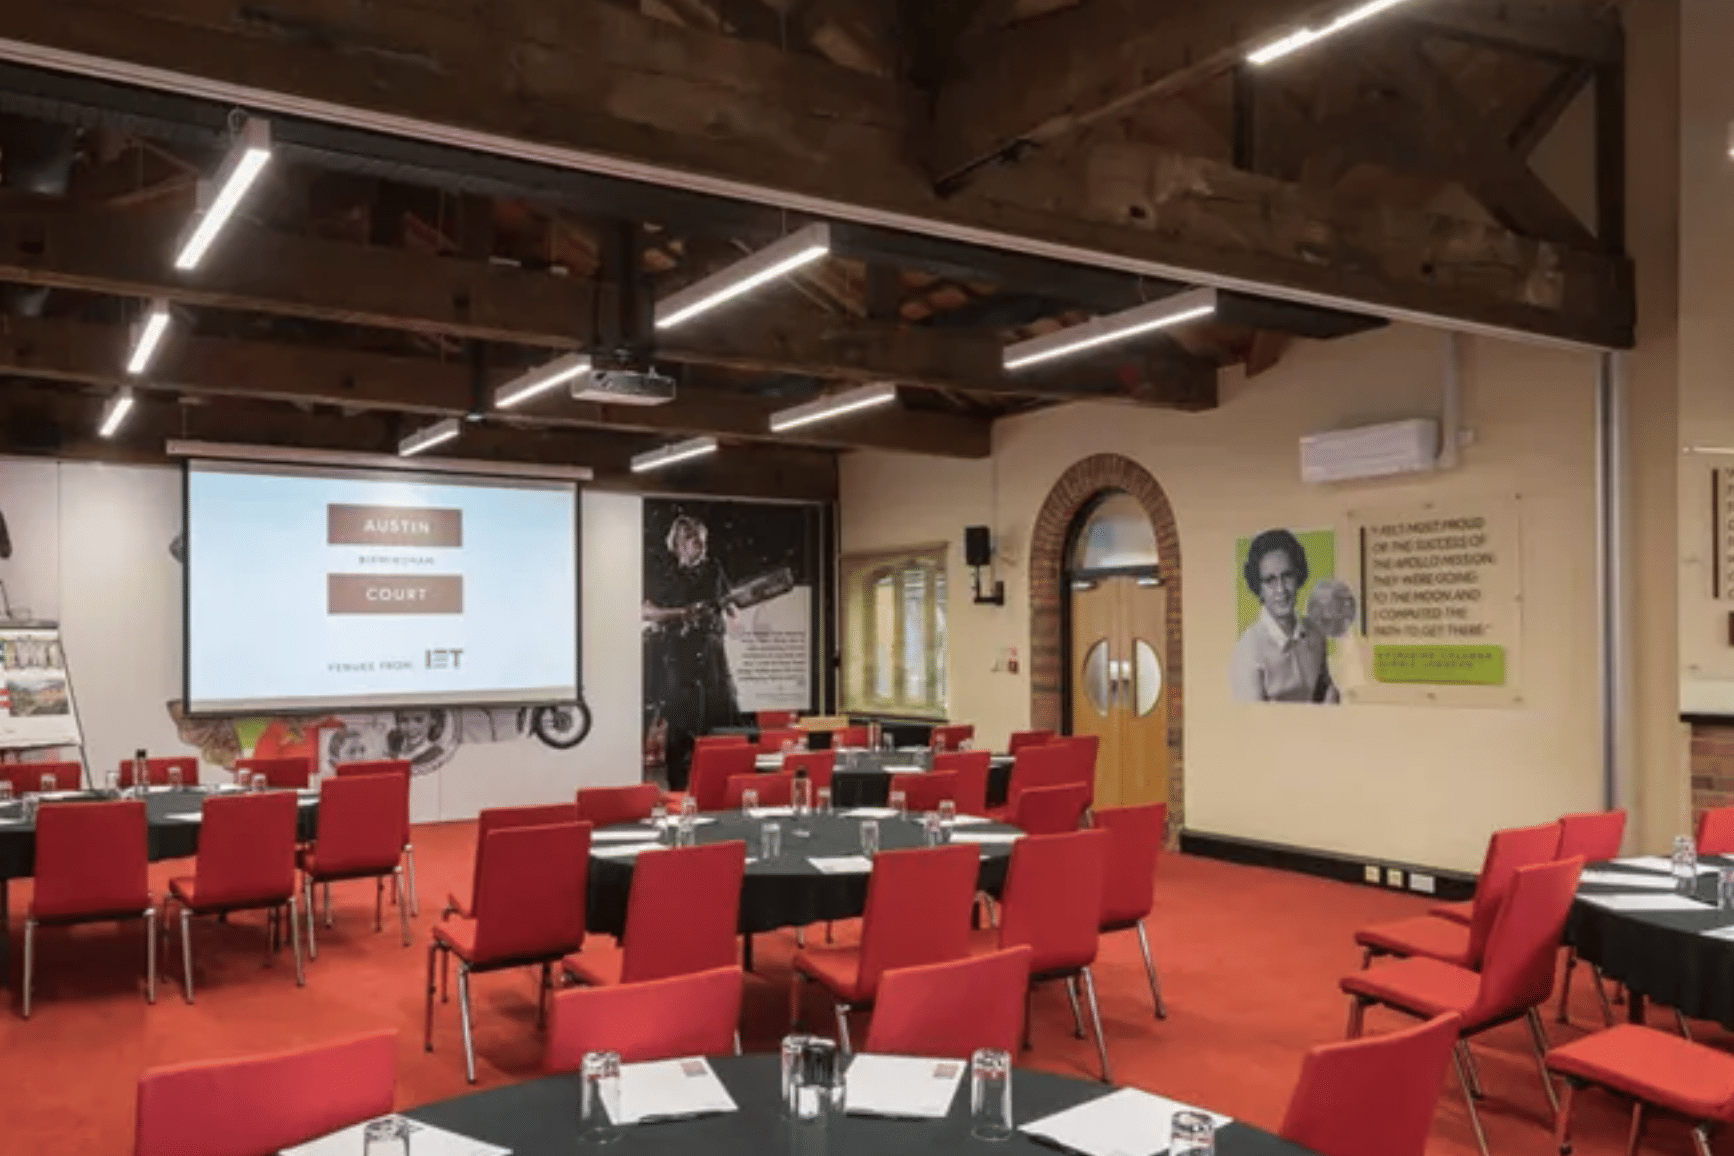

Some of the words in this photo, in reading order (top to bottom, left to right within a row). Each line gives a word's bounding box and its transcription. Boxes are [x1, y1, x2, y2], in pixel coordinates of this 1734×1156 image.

[363, 519, 430, 534] AUSTIN
[366, 588, 427, 601] COURT
[425, 648, 464, 670] IET
